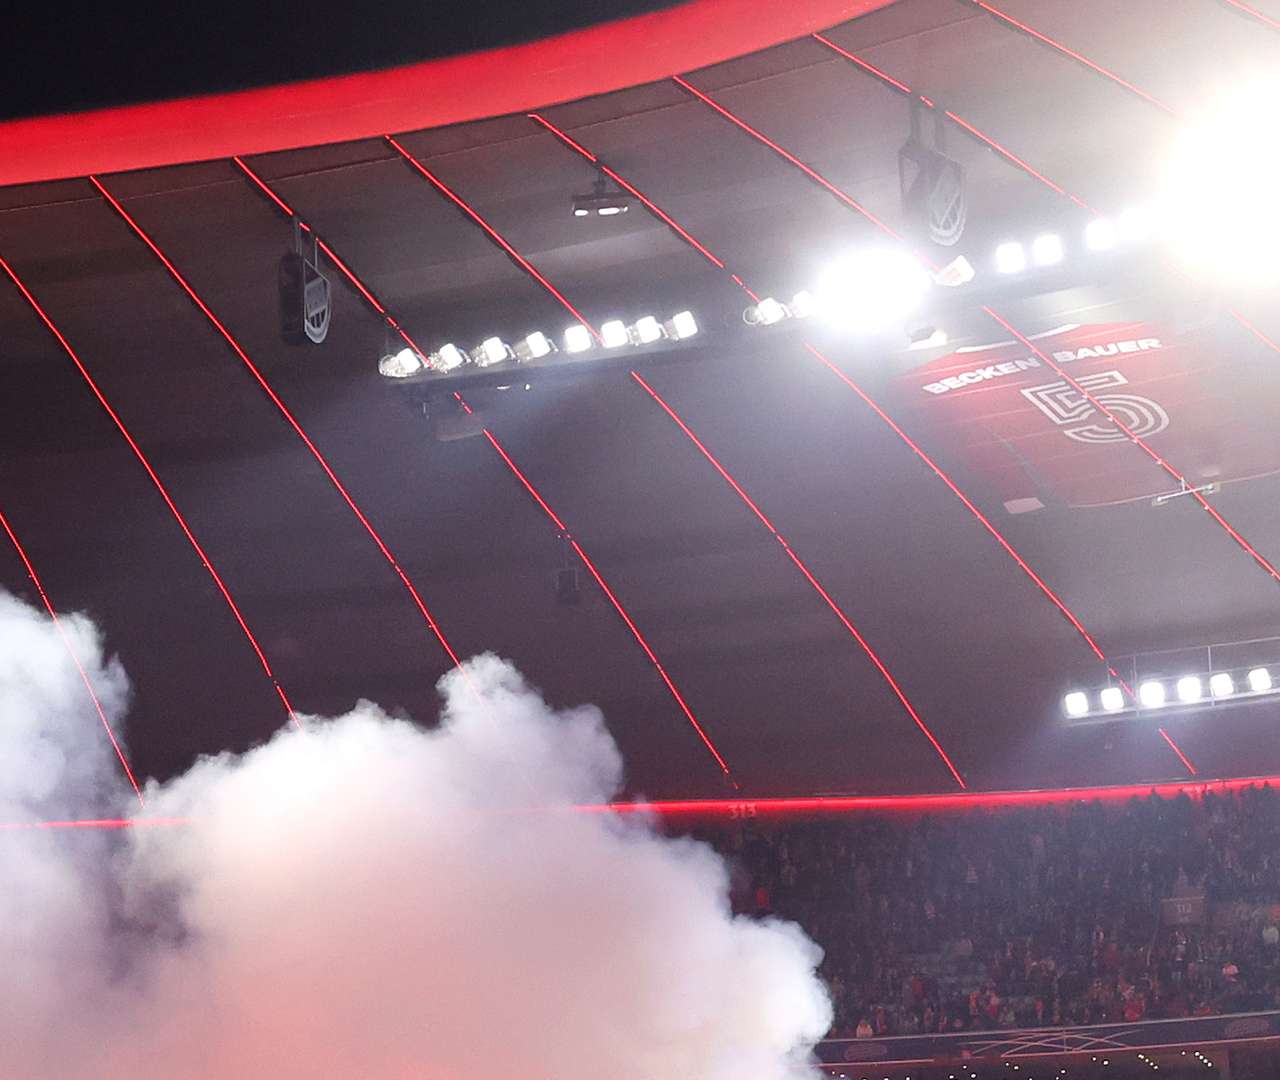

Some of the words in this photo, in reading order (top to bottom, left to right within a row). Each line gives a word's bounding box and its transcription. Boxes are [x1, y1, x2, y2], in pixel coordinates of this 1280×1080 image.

[923, 357, 1041, 394] BECKEN
[1053, 338, 1163, 363] BAUER
[1020, 371, 1169, 443] 5
